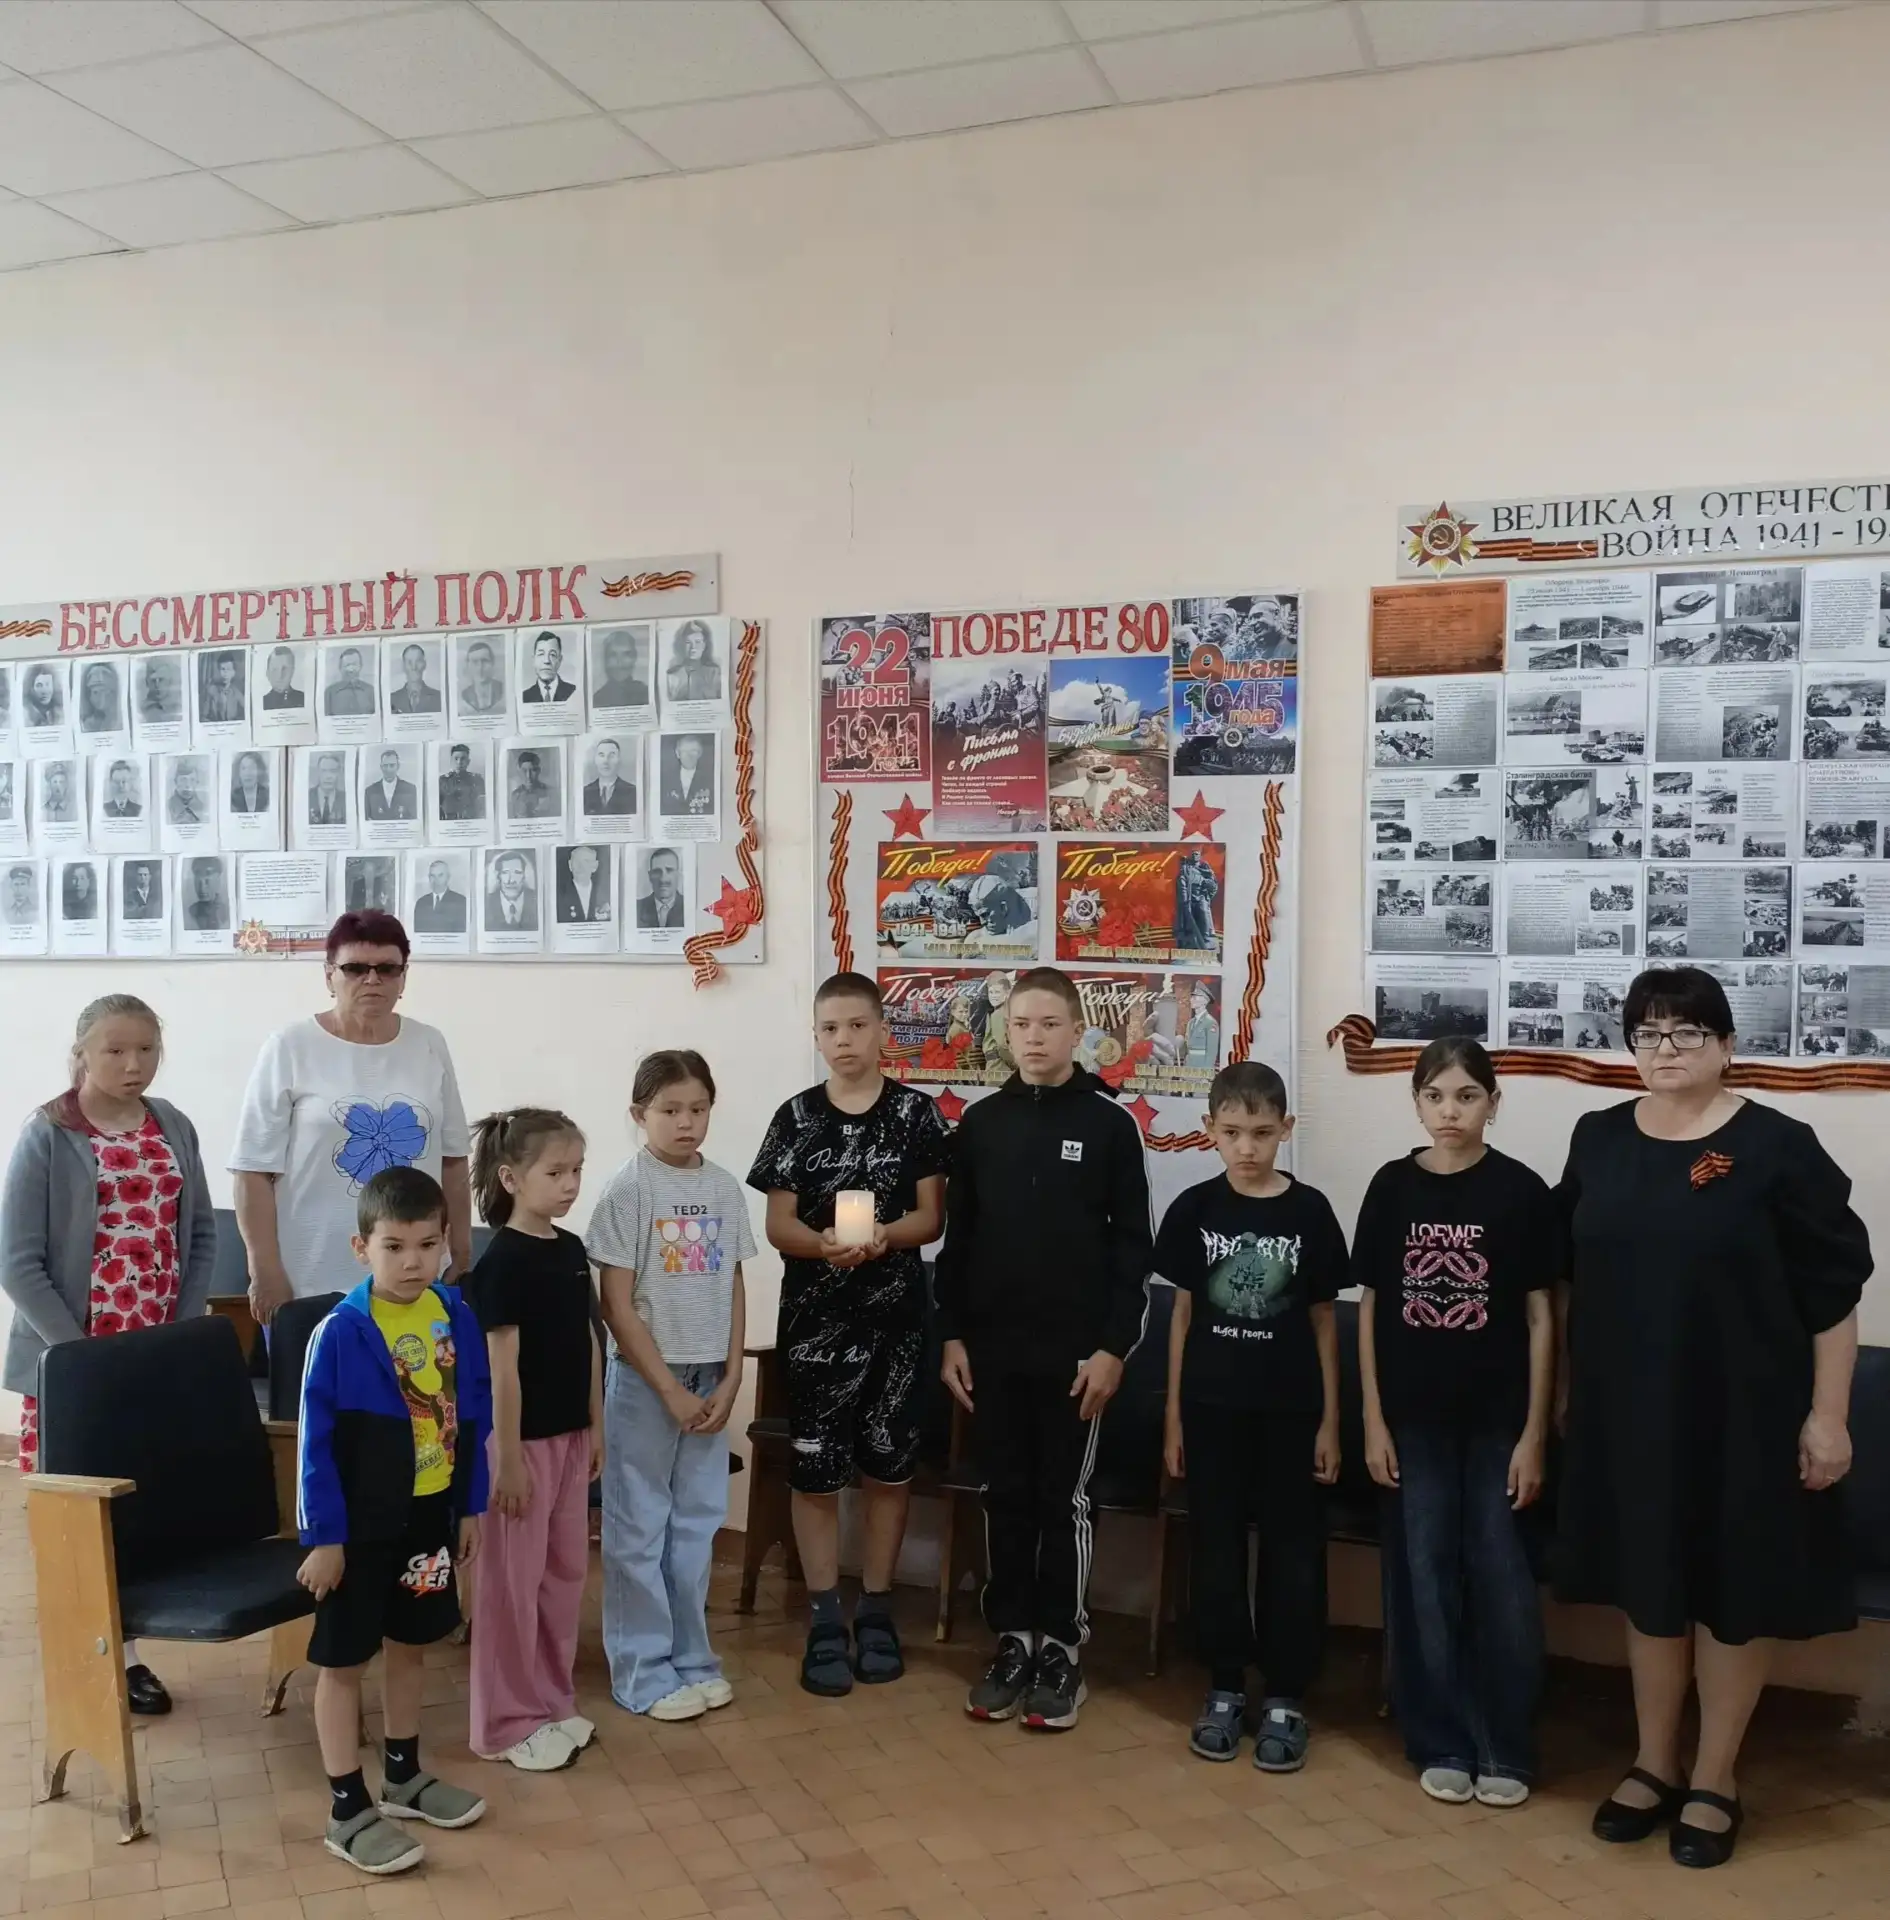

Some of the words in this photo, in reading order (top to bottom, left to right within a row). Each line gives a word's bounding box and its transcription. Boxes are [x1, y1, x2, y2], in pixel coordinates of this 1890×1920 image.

[1493, 495, 1675, 533] ВЕЛИКАЯ
[1700, 484, 1890, 519] ОТЕЧЕСТ
[1602, 523, 1741, 559] ВОЙНА
[1757, 521, 1820, 550] 1941
[1855, 516, 1890, 546] 19
[58, 572, 418, 652] БЕССМЕРТНЫЙ
[434, 564, 588, 628] ПОЛК
[931, 606, 1109, 659] ПОБЕДЕ
[1117, 602, 1169, 654] 80
[839, 627, 910, 685] 22
[1189, 642, 1225, 687] 9
[1224, 659, 1286, 681] мая
[1183, 681, 1285, 738] 1945
[1228, 708, 1276, 729] года
[826, 713, 921, 772] 1941
[947, 760, 955, 771] с
[960, 744, 1018, 772] фронта
[963, 729, 1018, 752] Письма
[1505, 771, 1569, 780] Сталинградская
[1570, 770, 1593, 779] битва
[881, 847, 992, 888] Победа!
[1061, 847, 1177, 890] Победа!
[881, 973, 989, 1014] Победа!
[672, 1204, 708, 1216] TED2
[1242, 1328, 1274, 1340] PEOPLE
